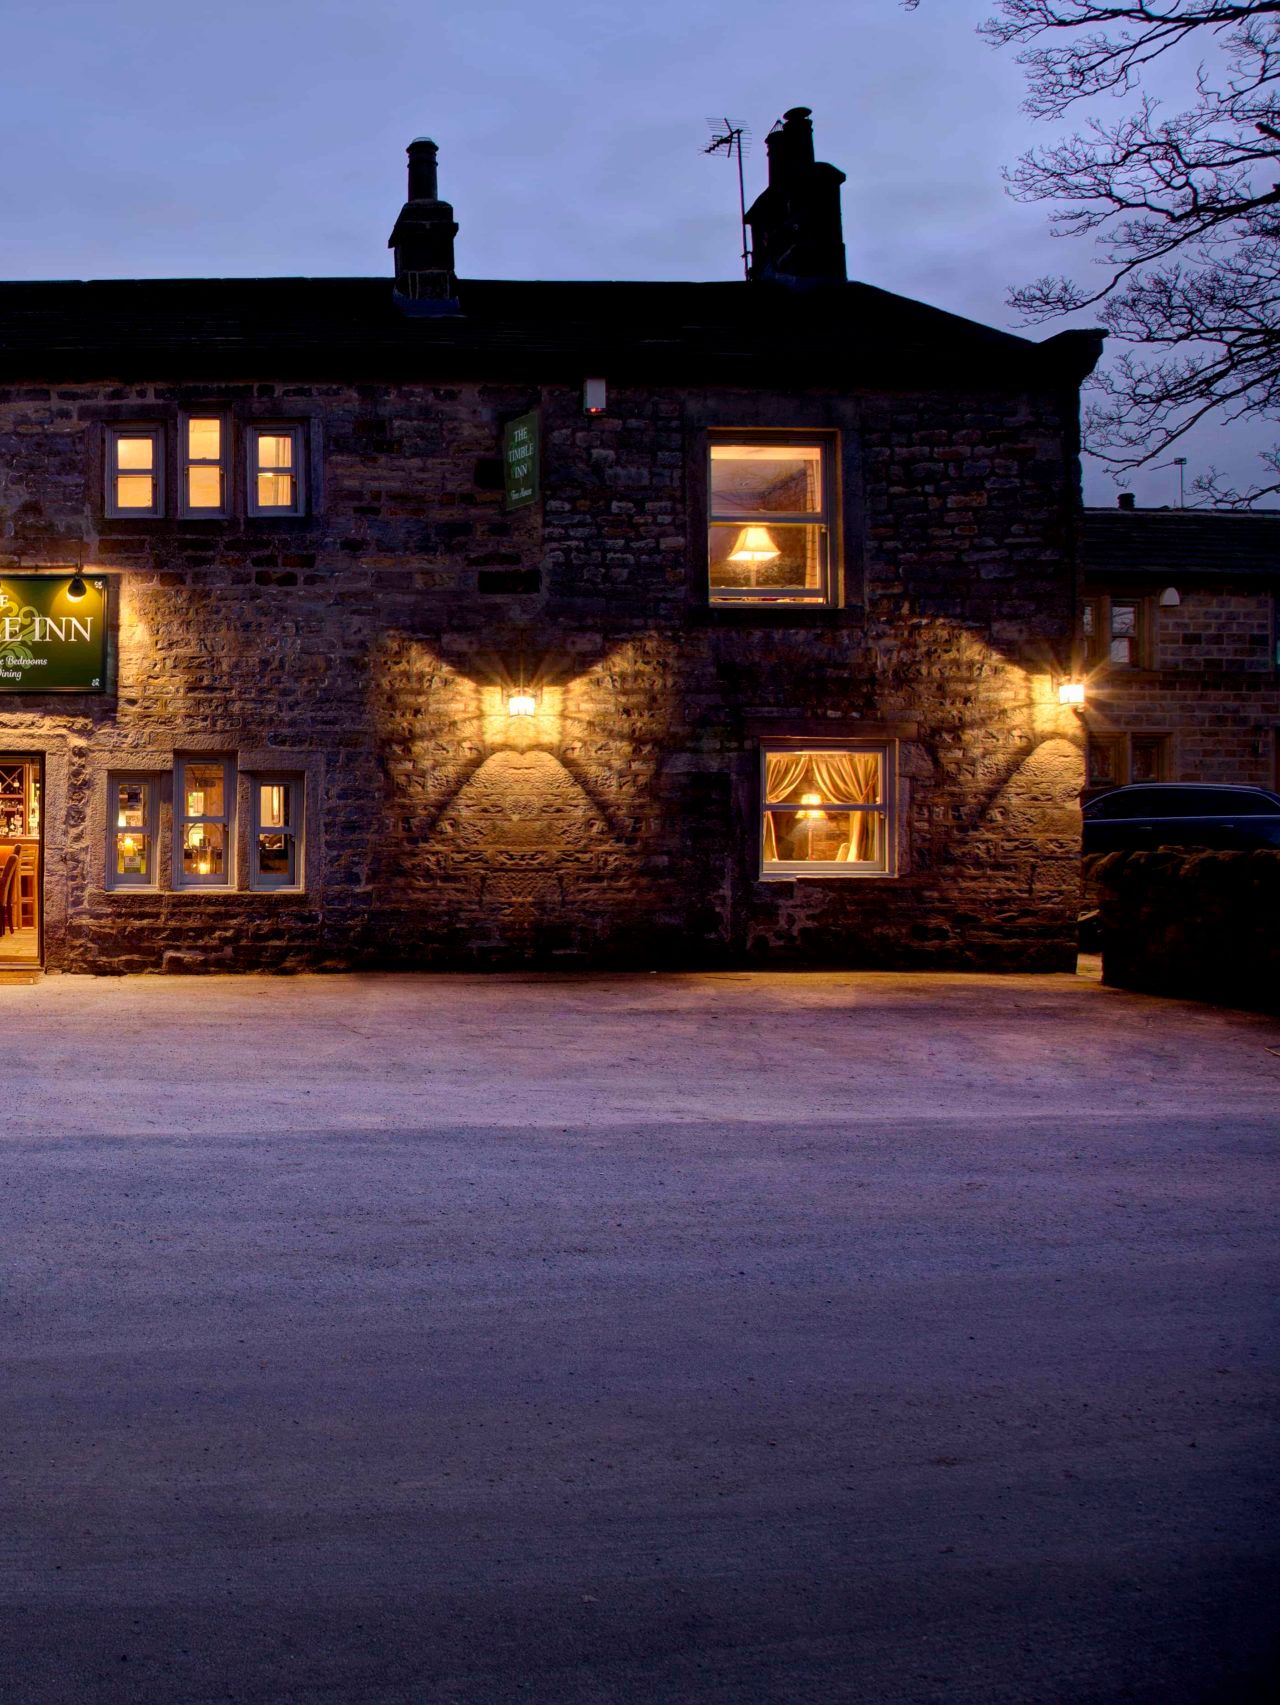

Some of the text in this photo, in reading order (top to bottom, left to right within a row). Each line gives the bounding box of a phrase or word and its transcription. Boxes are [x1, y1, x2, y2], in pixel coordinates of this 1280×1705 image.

[514, 427, 528, 442] THE
[507, 443, 534, 462] TIMBLE
[515, 464, 528, 478] INN
[32, 617, 94, 642] INN
[6, 655, 48, 666] Bedrooms
